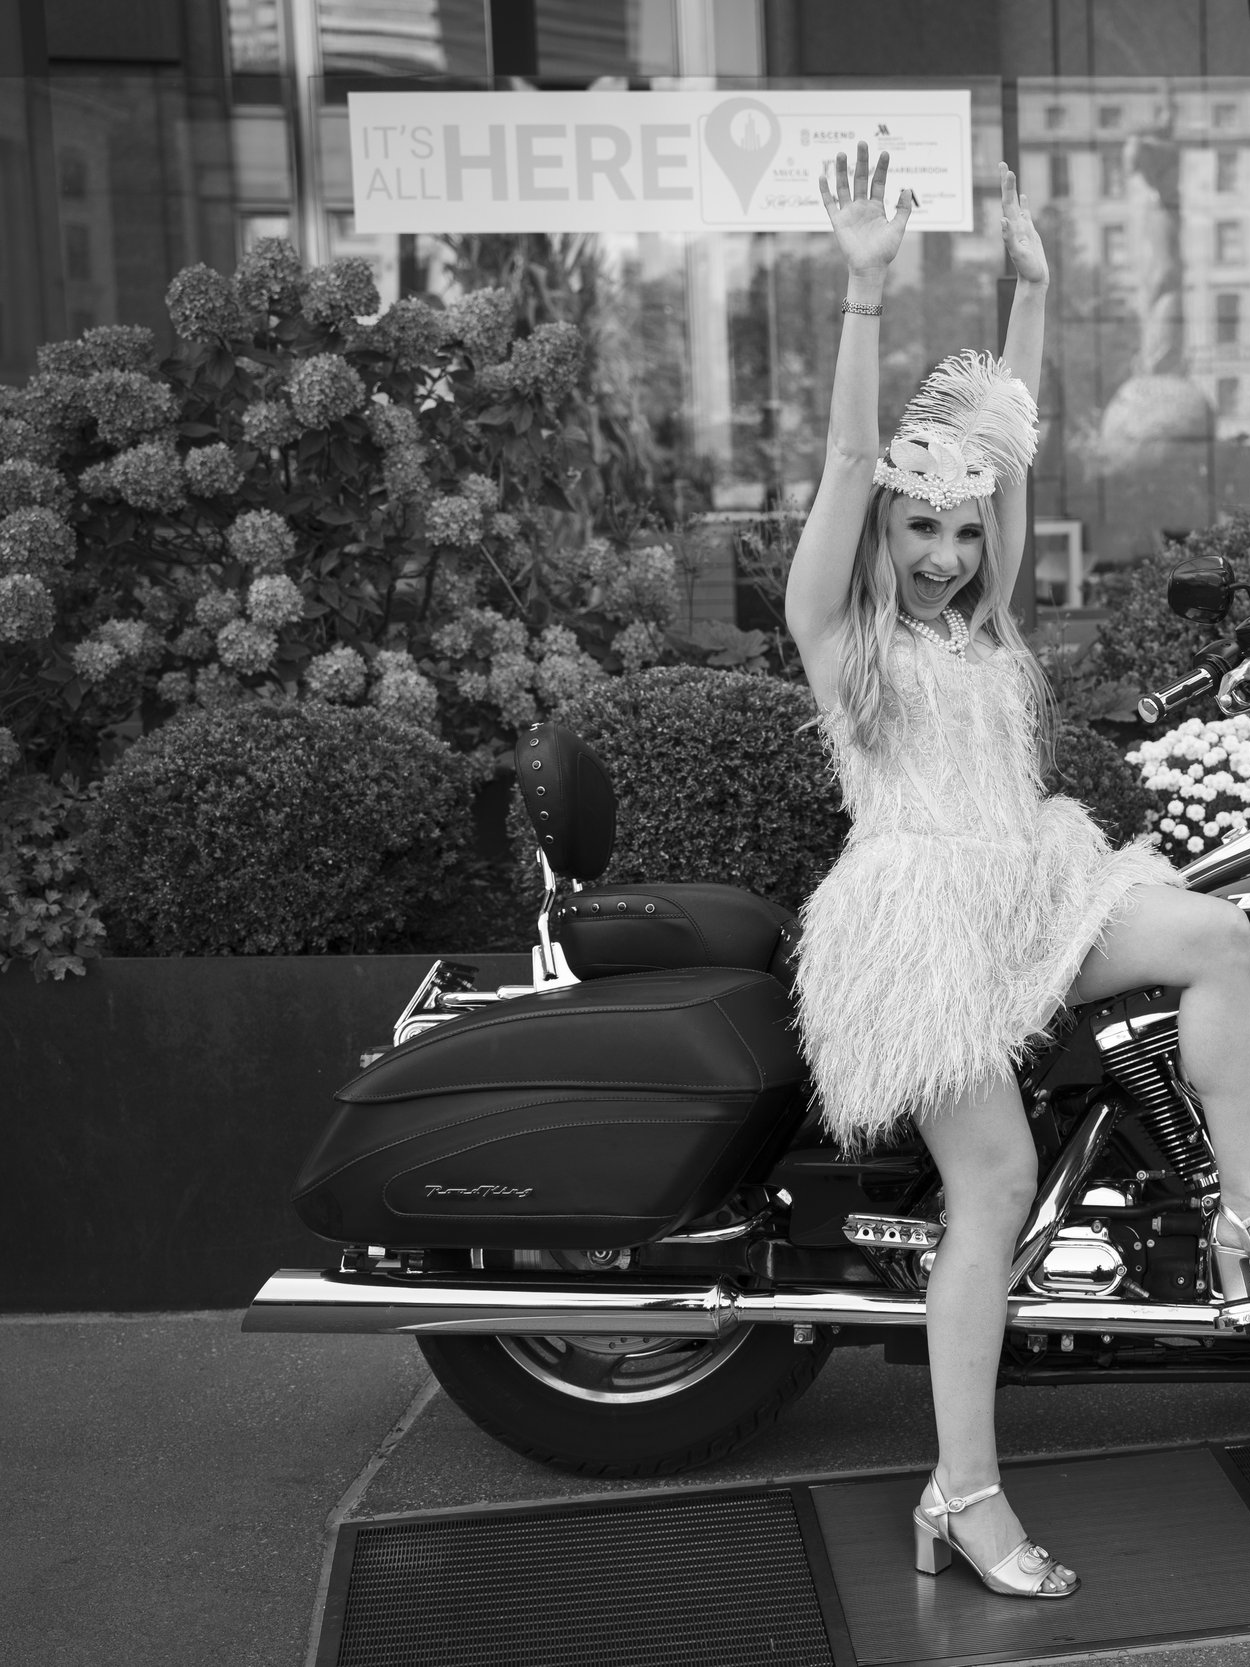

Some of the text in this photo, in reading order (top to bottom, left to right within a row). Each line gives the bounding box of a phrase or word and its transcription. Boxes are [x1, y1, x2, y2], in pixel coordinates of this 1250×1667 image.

[362, 124, 435, 160] IT'S
[442, 123, 694, 202] HERE
[365, 166, 442, 201] ALL
